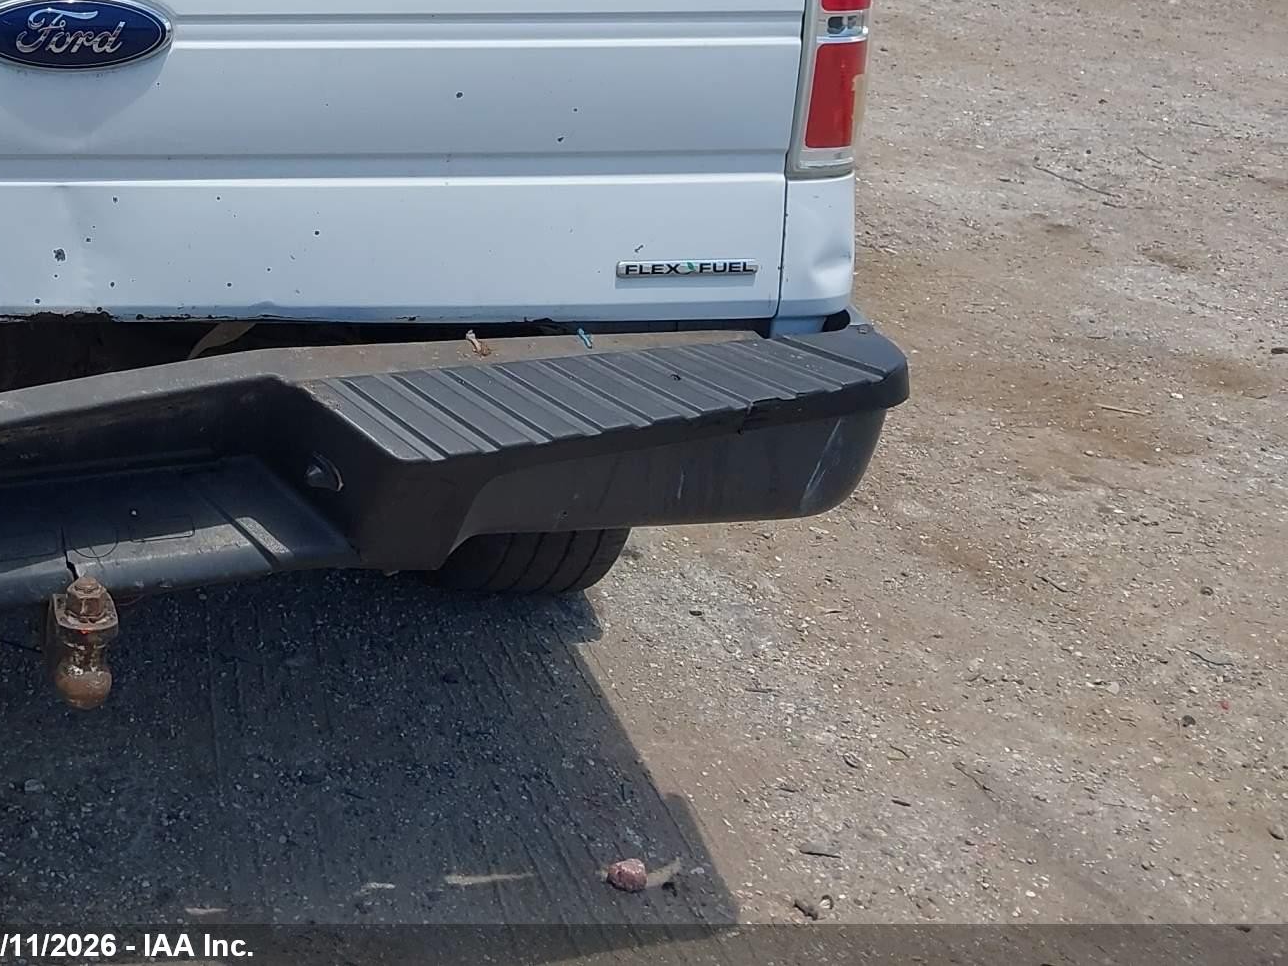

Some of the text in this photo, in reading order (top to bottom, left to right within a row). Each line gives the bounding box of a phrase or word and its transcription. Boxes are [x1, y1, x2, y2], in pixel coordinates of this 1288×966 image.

[15, 7, 126, 53] Ford
[625, 261, 754, 275] FLEX FUEL
